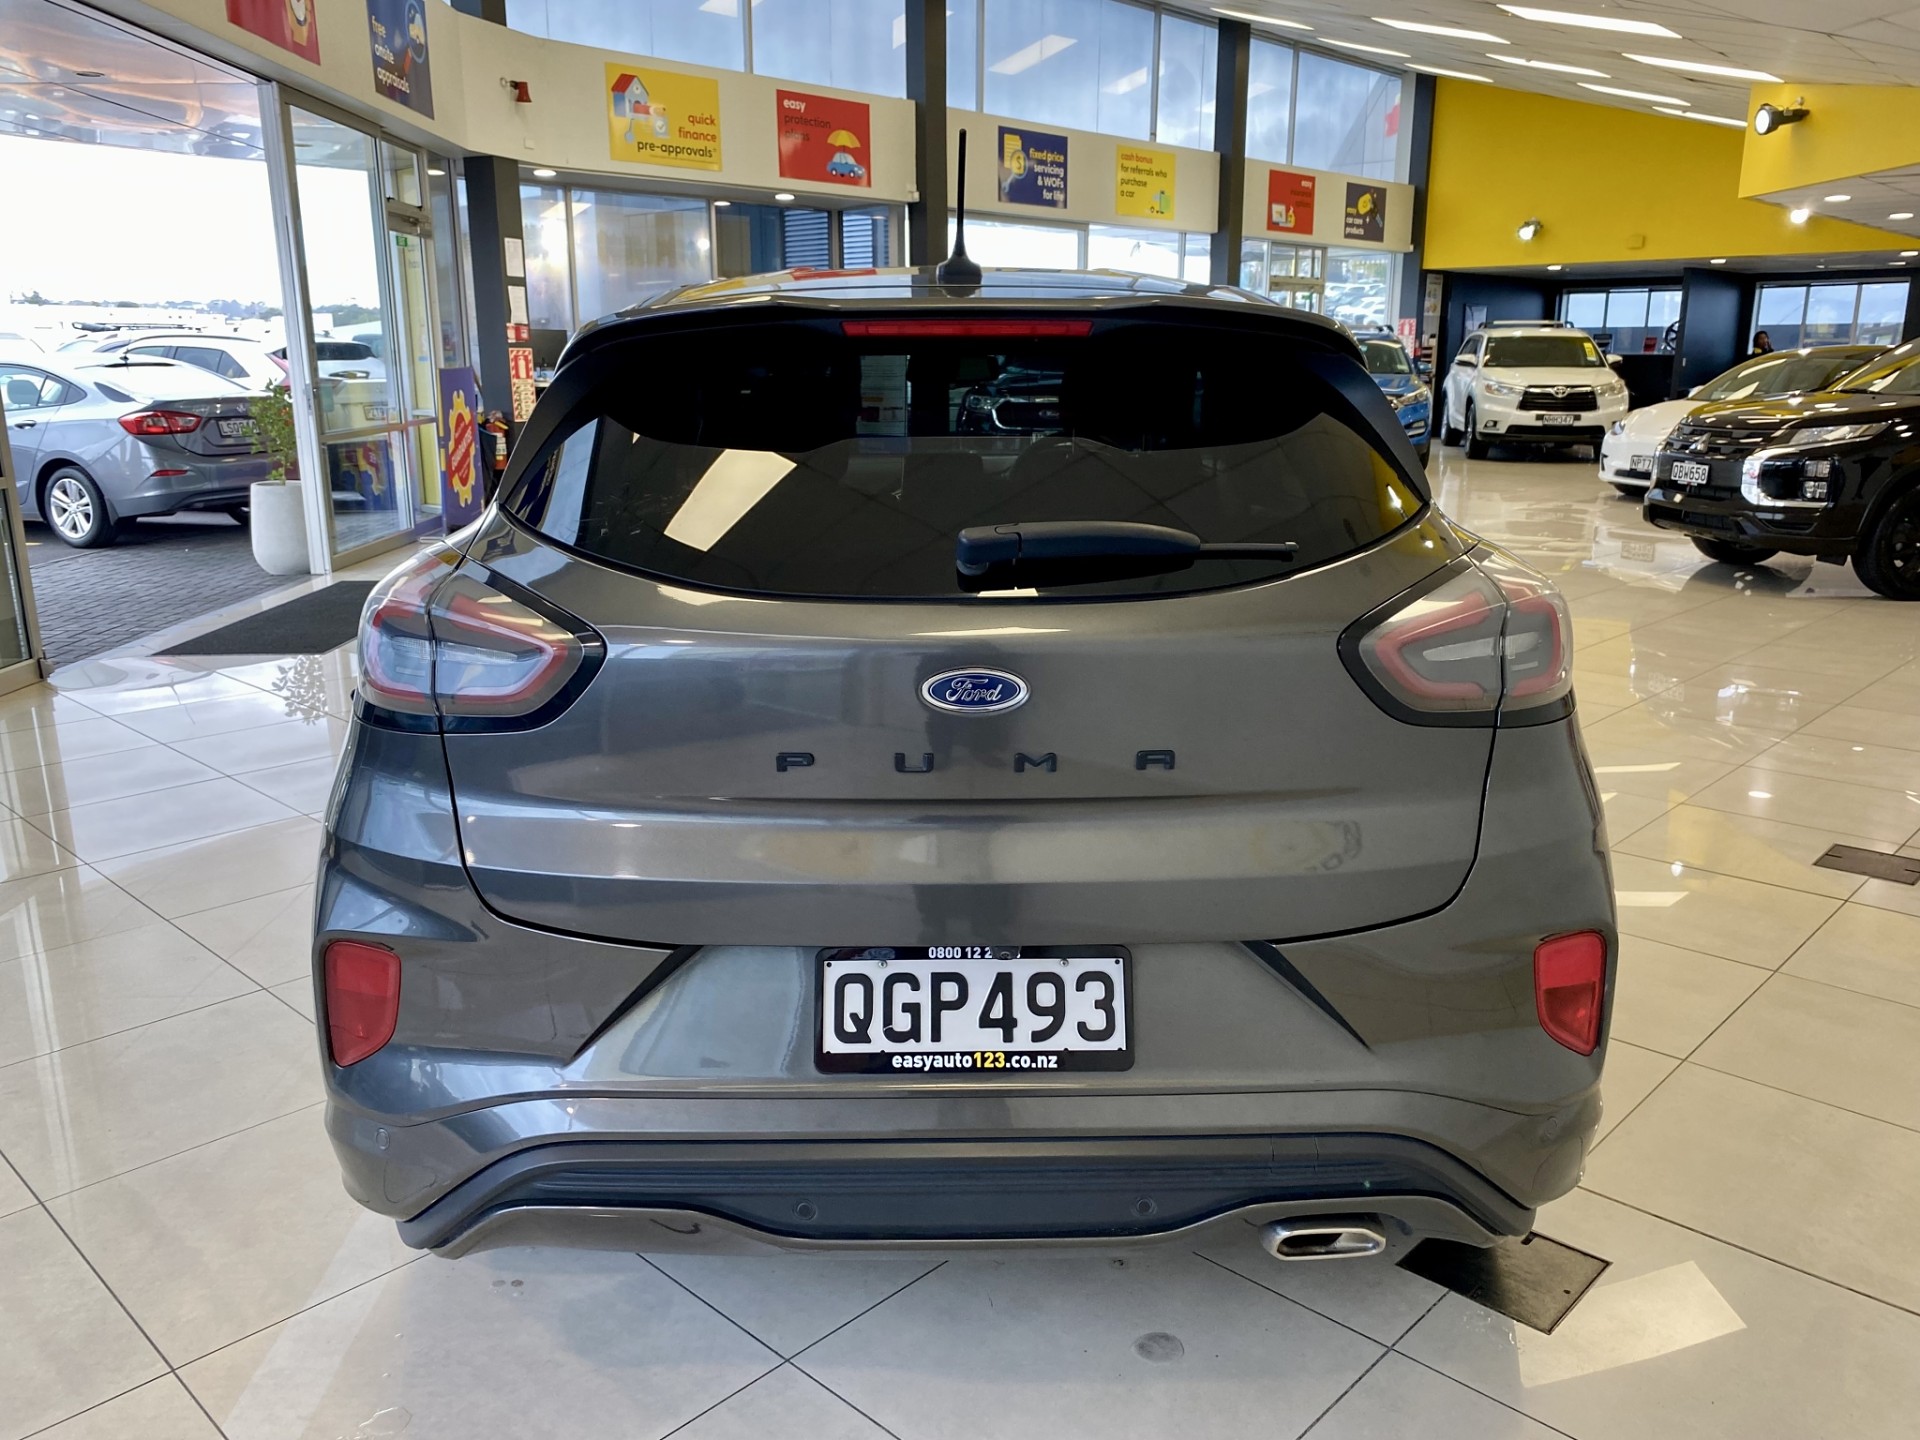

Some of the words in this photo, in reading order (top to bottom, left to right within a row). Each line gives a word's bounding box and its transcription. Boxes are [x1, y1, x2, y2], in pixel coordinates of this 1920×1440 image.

[377, 67, 410, 94] appraisals
[783, 99, 806, 113] easy
[687, 113, 716, 126] quick
[784, 115, 831, 128] protection
[678, 126, 717, 142] finance
[1029, 147, 1047, 160] fixed
[1047, 151, 1065, 163] price
[1120, 152, 1135, 161] cash
[1135, 153, 1153, 164] bonus
[1034, 163, 1065, 178] servicing
[1120, 163, 1129, 173] for
[1130, 165, 1154, 176] referrals
[1155, 169, 1168, 178] who
[1037, 175, 1043, 186] &
[1043, 176, 1064, 188] WOFs
[1120, 177, 1148, 188] purchase
[1042, 189, 1053, 200] for
[1631, 458, 1652, 469] NPT7
[1672, 464, 1707, 482] QBW658
[945, 677, 1004, 702] Ford
[776, 749, 1176, 773] PUMA
[928, 946, 962, 959] 0800
[965, 946, 981, 959] 12
[834, 970, 1116, 1044] QGP493
[891, 1051, 1058, 1071] easyauto123.co.nz
